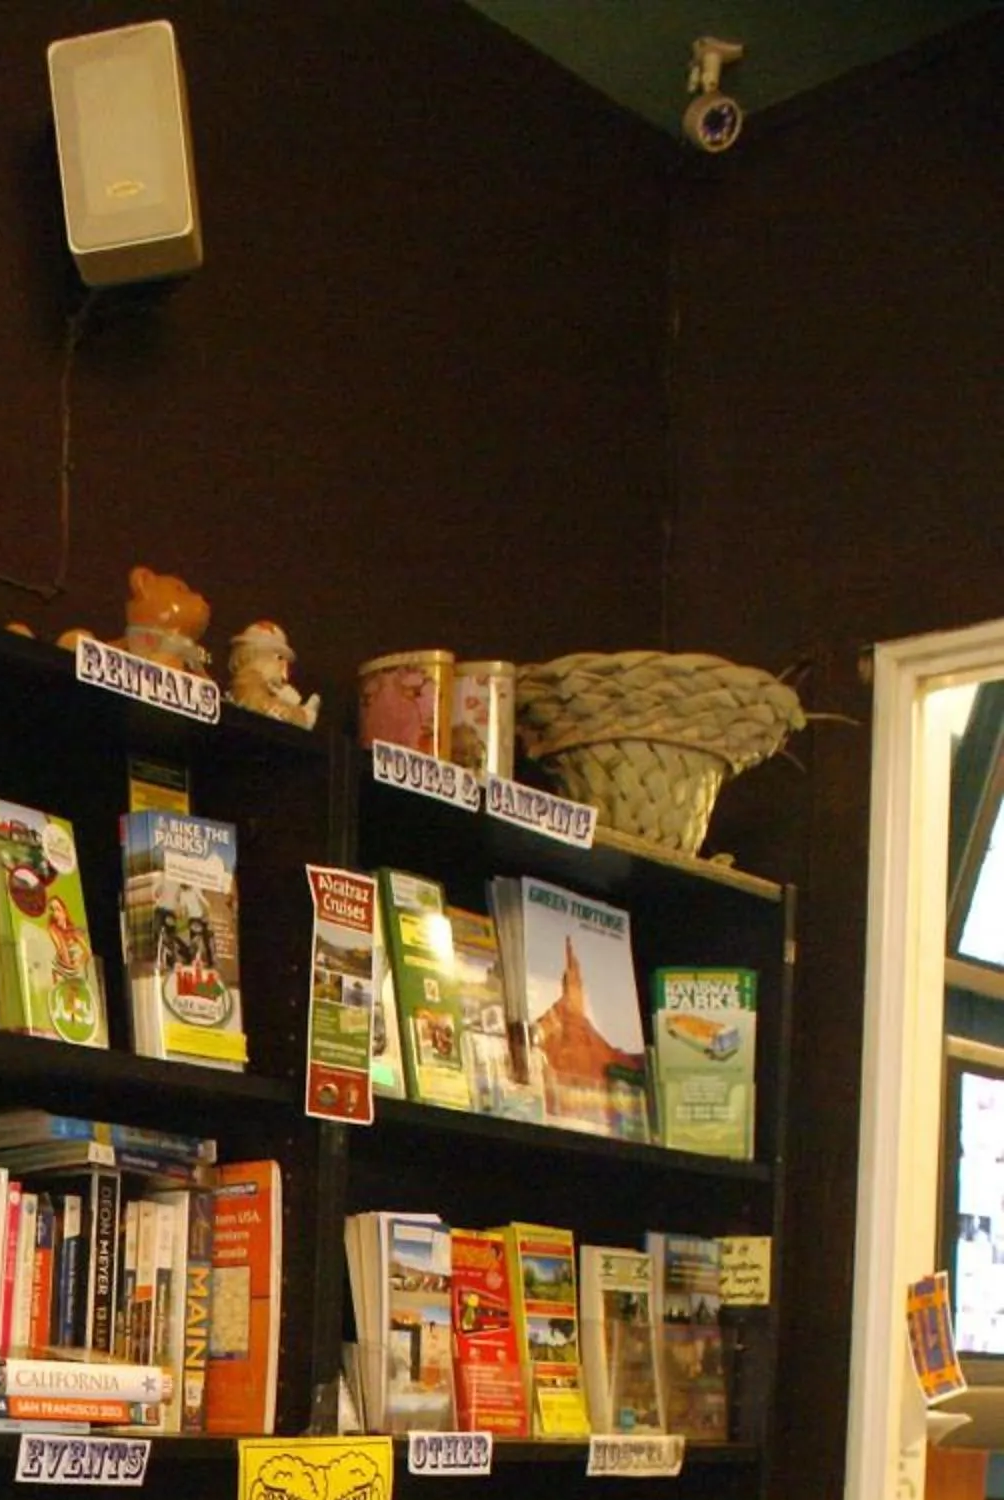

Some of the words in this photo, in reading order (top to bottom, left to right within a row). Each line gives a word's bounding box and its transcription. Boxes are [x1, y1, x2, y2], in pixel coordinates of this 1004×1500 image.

[82, 641, 219, 721] RENTALS
[375, 744, 456, 799] TOURS
[488, 777, 592, 839] CAMPING
[154, 829, 209, 855] PARKS!
[204, 824, 230, 845] THE
[318, 873, 370, 903] Alcatraz
[323, 892, 367, 921] Cruises
[98, 1185, 113, 1238] DEON
[97, 1239, 111, 1298] MEYER
[14, 1368, 121, 1392] CALIFORNIA
[17, 1401, 38, 1414] SAN
[40, 1402, 97, 1417] FRANCISCO
[21, 1438, 146, 1481] EVENTS
[411, 1435, 490, 1469] OTHER
